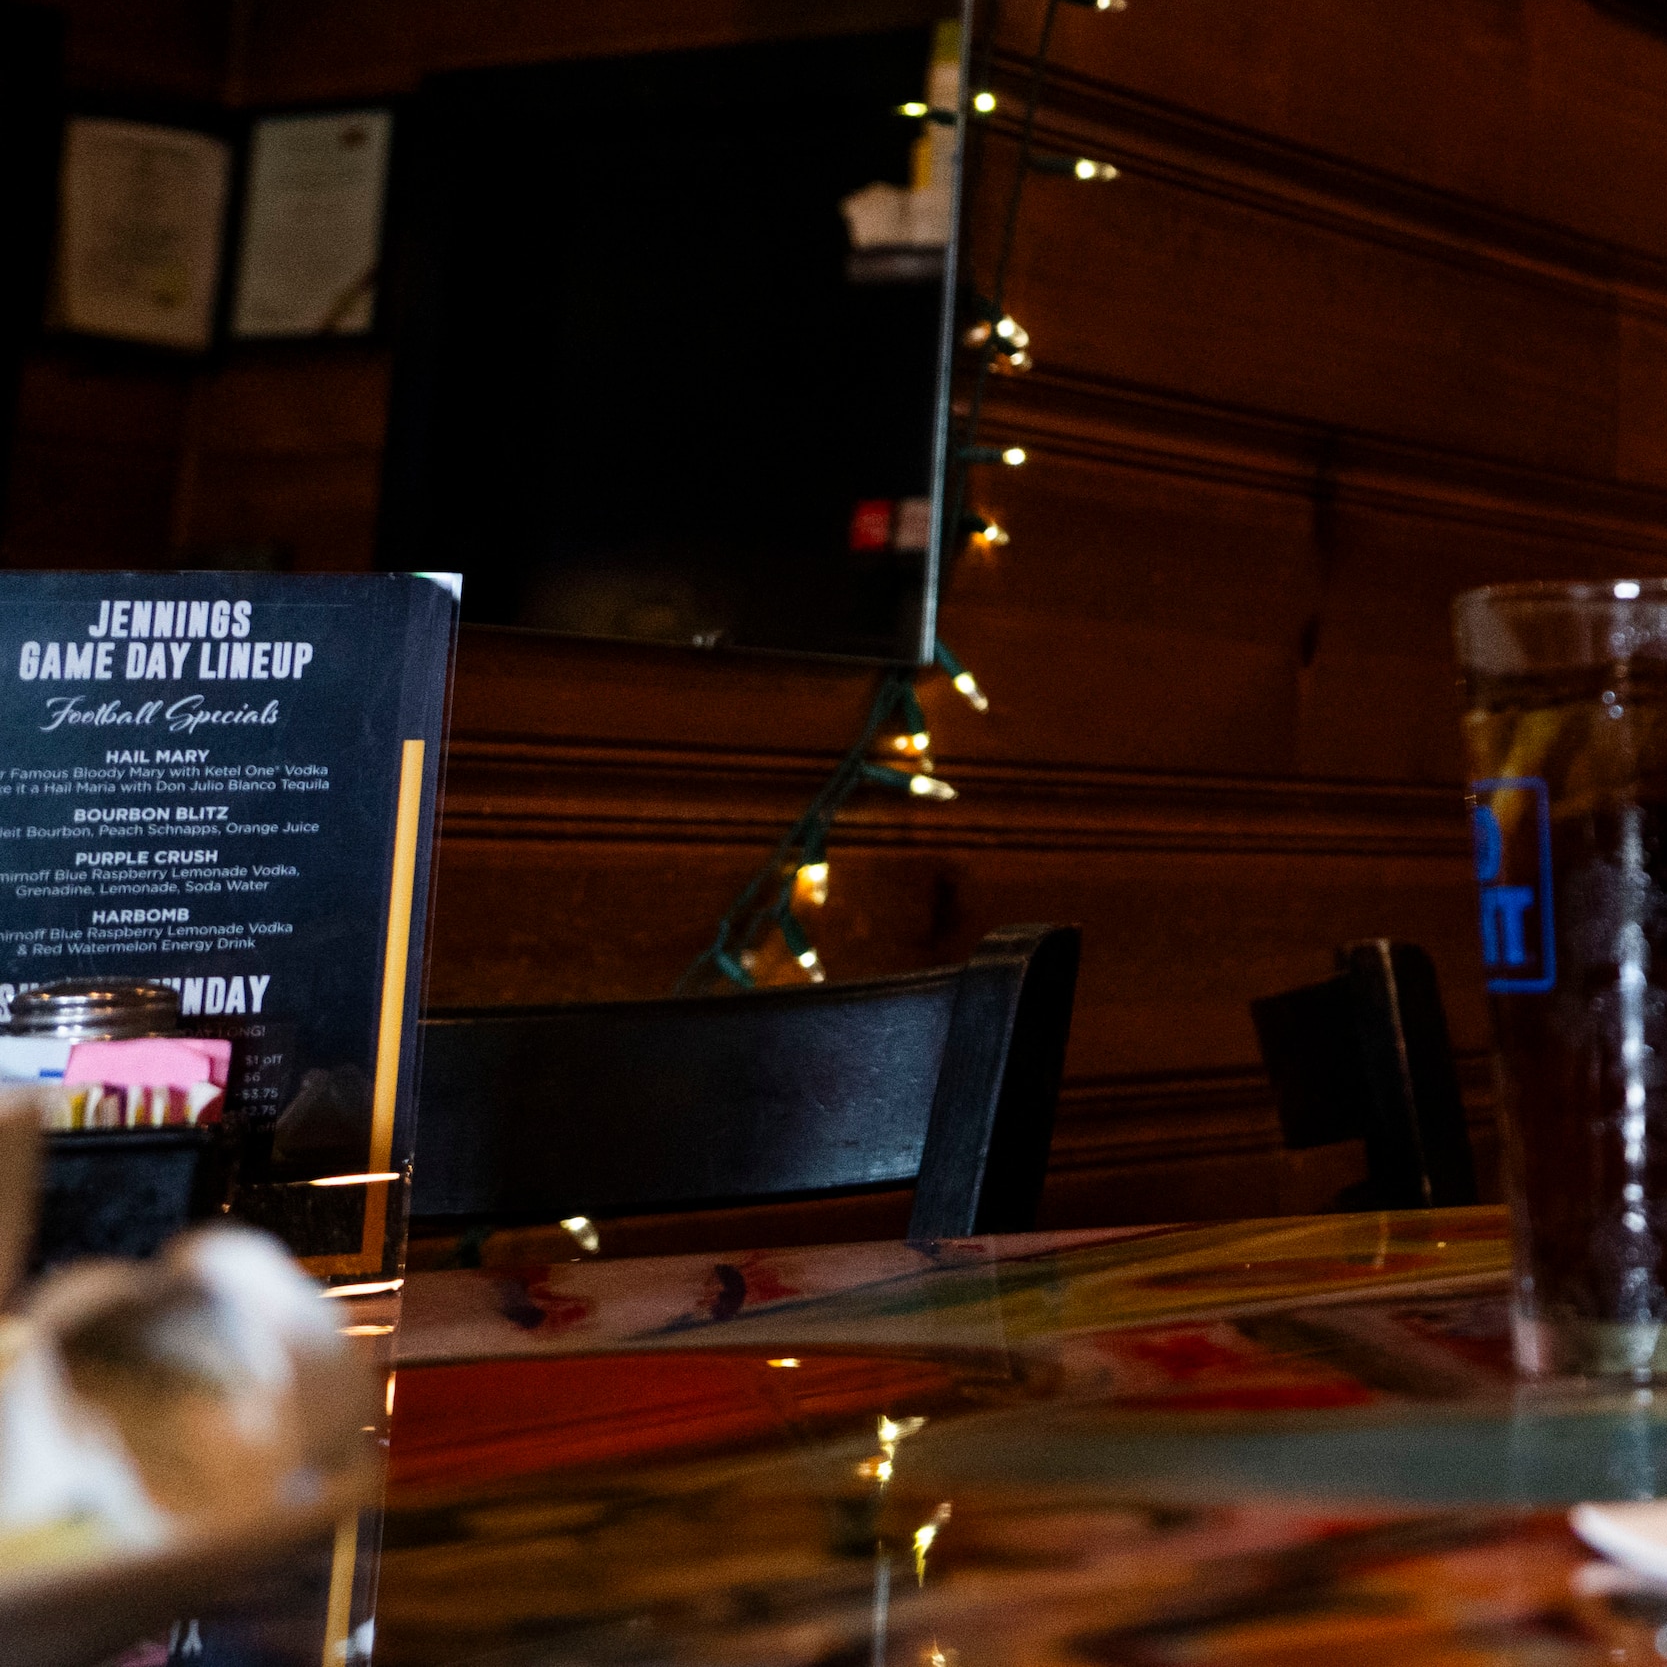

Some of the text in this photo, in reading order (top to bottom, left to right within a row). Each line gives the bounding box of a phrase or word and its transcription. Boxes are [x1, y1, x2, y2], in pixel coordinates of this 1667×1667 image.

[88, 600, 253, 639] JENNINGS
[19, 641, 314, 682] GAME DAY LINEUP
[40, 693, 281, 734] Football Specials
[106, 748, 210, 764] HAIL MARY
[10, 767, 69, 781] Famous
[73, 767, 126, 780] Bloody
[129, 766, 166, 780] Mary
[169, 765, 200, 777] with
[205, 764, 242, 777] Ketel
[284, 764, 329, 776] Vodka
[16, 783, 27, 795] it
[31, 785, 40, 795] a
[44, 783, 73, 795] Hail
[121, 781, 152, 793] with
[156, 780, 186, 793] Don
[190, 780, 224, 792] Julio
[228, 779, 277, 792] Blanco
[281, 779, 330, 792] Tequila
[74, 806, 230, 823] BOURBON BLITZ
[26, 825, 94, 838] Bourbon,
[100, 824, 143, 836] Peach
[148, 823, 221, 837] Schnapps,
[226, 822, 279, 835] Orange
[282, 821, 320, 833] Juice
[75, 849, 219, 866] PURPLE CRUSH
[54, 869, 88, 882] Blue
[92, 867, 168, 882] Raspberry
[172, 865, 248, 878] Lemonade
[252, 864, 300, 877] Vodka,
[15, 880, 270, 897] Grenadine, Lemonade, Soda Water
[92, 907, 190, 924] HARBOMB
[50, 928, 83, 940] Blue
[87, 925, 164, 941] Raspberry
[168, 923, 244, 936] Lemonade
[249, 921, 293, 934] Vodka
[17, 936, 256, 956] & Red Watermelon Energy Drink
[262, 1052, 284, 1065] off
